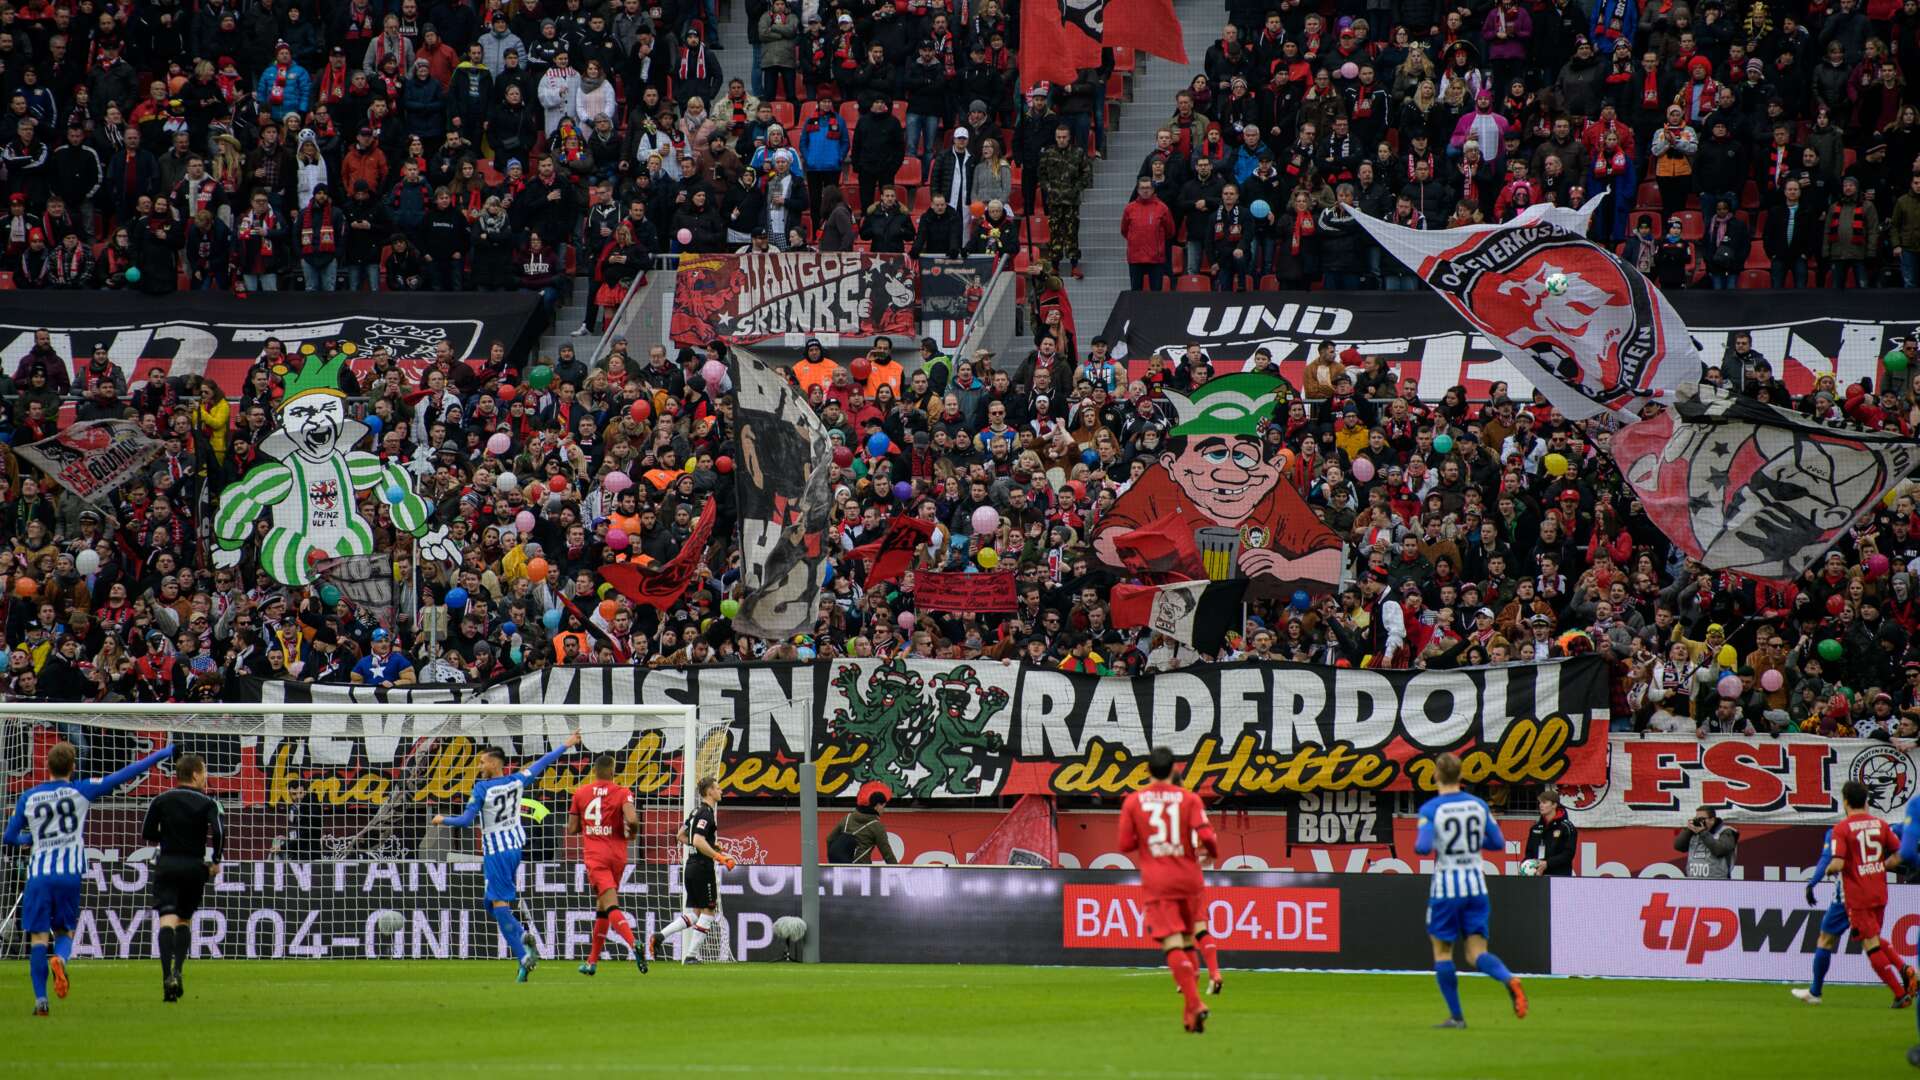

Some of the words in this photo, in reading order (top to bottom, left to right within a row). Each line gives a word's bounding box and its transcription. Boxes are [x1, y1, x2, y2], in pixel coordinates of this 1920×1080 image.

[732, 274, 860, 336] SKUNKS
[1187, 303, 1353, 337] UND
[313, 511, 339, 519] PRINZ
[1182, 734, 1394, 792] Hütte
[1623, 741, 1838, 812] FSI
[34, 797, 79, 840] 28
[493, 788, 519, 823] 27
[584, 797, 603, 826] 4
[1141, 802, 1180, 845] 31
[1298, 813, 1377, 843] BOYZ
[1444, 815, 1480, 855] 26
[1856, 829, 1882, 864] 15
[1689, 863, 1709, 877] FOTO
